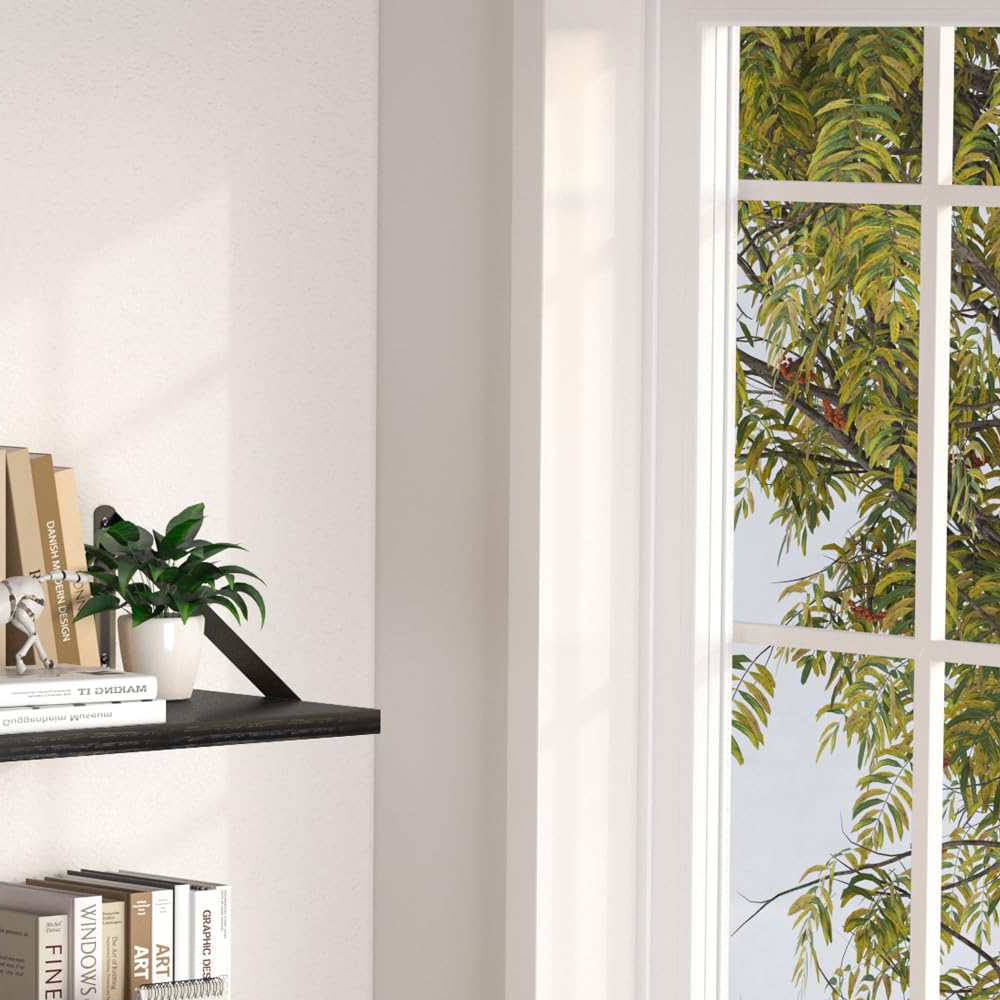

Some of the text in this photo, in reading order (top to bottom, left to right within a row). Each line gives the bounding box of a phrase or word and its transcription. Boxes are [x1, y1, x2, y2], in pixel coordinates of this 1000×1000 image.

[46, 520, 71, 643] DANISH MDERN DESIGN
[44, 944, 63, 1000] FINE
[80, 904, 97, 996] WINDOWS
[134, 944, 150, 980] ART
[156, 944, 171, 978] ART
[202, 909, 212, 981] GRAPHIC DES
